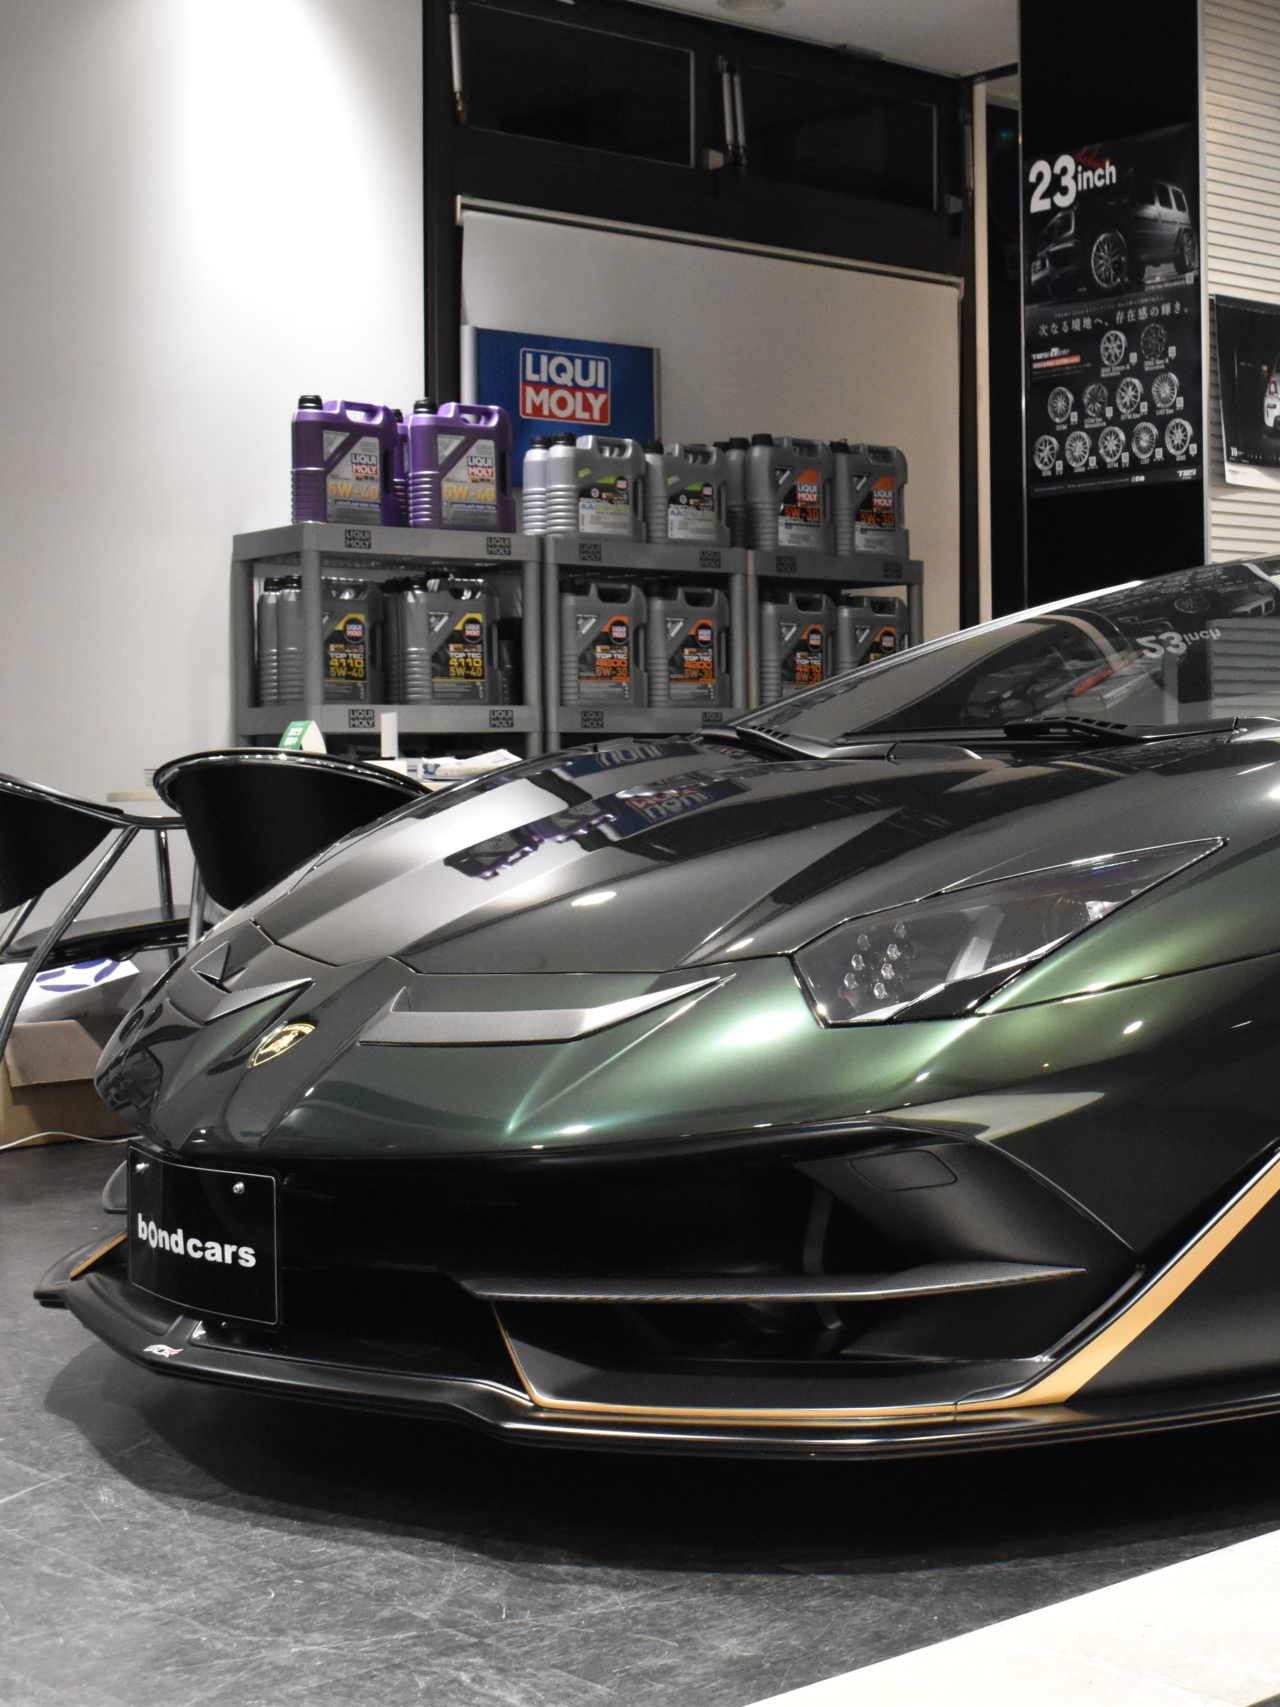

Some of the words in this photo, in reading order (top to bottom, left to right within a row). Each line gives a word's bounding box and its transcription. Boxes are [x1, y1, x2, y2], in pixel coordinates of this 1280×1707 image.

[525, 353, 606, 388] LIQUI
[525, 386, 607, 421] MOLY
[352, 454, 378, 465] LIQUI
[468, 456, 493, 467] LIQUI
[352, 464, 378, 474] MOLY
[468, 466, 494, 476] MOLY
[328, 481, 380, 501] 5W-40
[443, 484, 495, 502] 5W-40
[797, 484, 818, 493] LIQUI
[797, 492, 818, 502] MOLY
[873, 490, 893, 499] LIQUI
[873, 498, 893, 507] MOLY
[785, 506, 820, 520] 5W-30
[861, 512, 895, 525] 5W-30
[346, 530, 370, 539] LIQUI
[346, 539, 370, 548] MOLY
[349, 710, 374, 719] LIQUI
[490, 710, 513, 719] LIQUI
[349, 719, 374, 728] MOLY
[490, 719, 513, 727] MOLY
